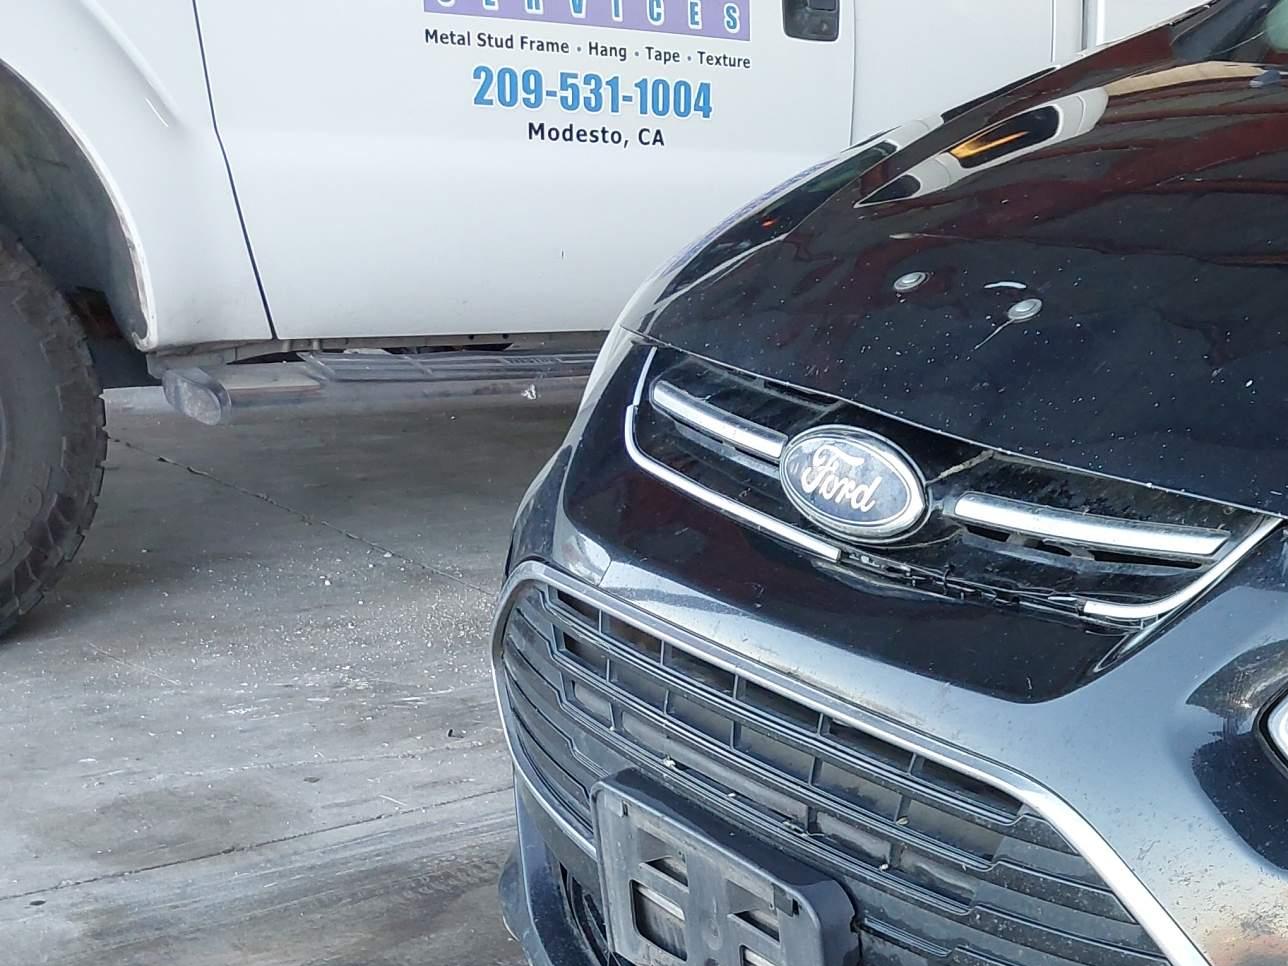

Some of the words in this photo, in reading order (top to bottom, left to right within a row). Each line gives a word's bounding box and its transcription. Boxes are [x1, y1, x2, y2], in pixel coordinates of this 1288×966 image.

[438, 0, 738, 30] VICES
[425, 29, 471, 46] Metal
[477, 33, 514, 49] Stud
[521, 36, 569, 53] Frame
[588, 42, 627, 61] Hang
[645, 47, 680, 64] Tape
[697, 51, 751, 68] Texture
[473, 66, 712, 118] 209-531-1004
[528, 122, 629, 148] Modesto,
[638, 128, 664, 146] CA
[801, 444, 882, 512] Ford
